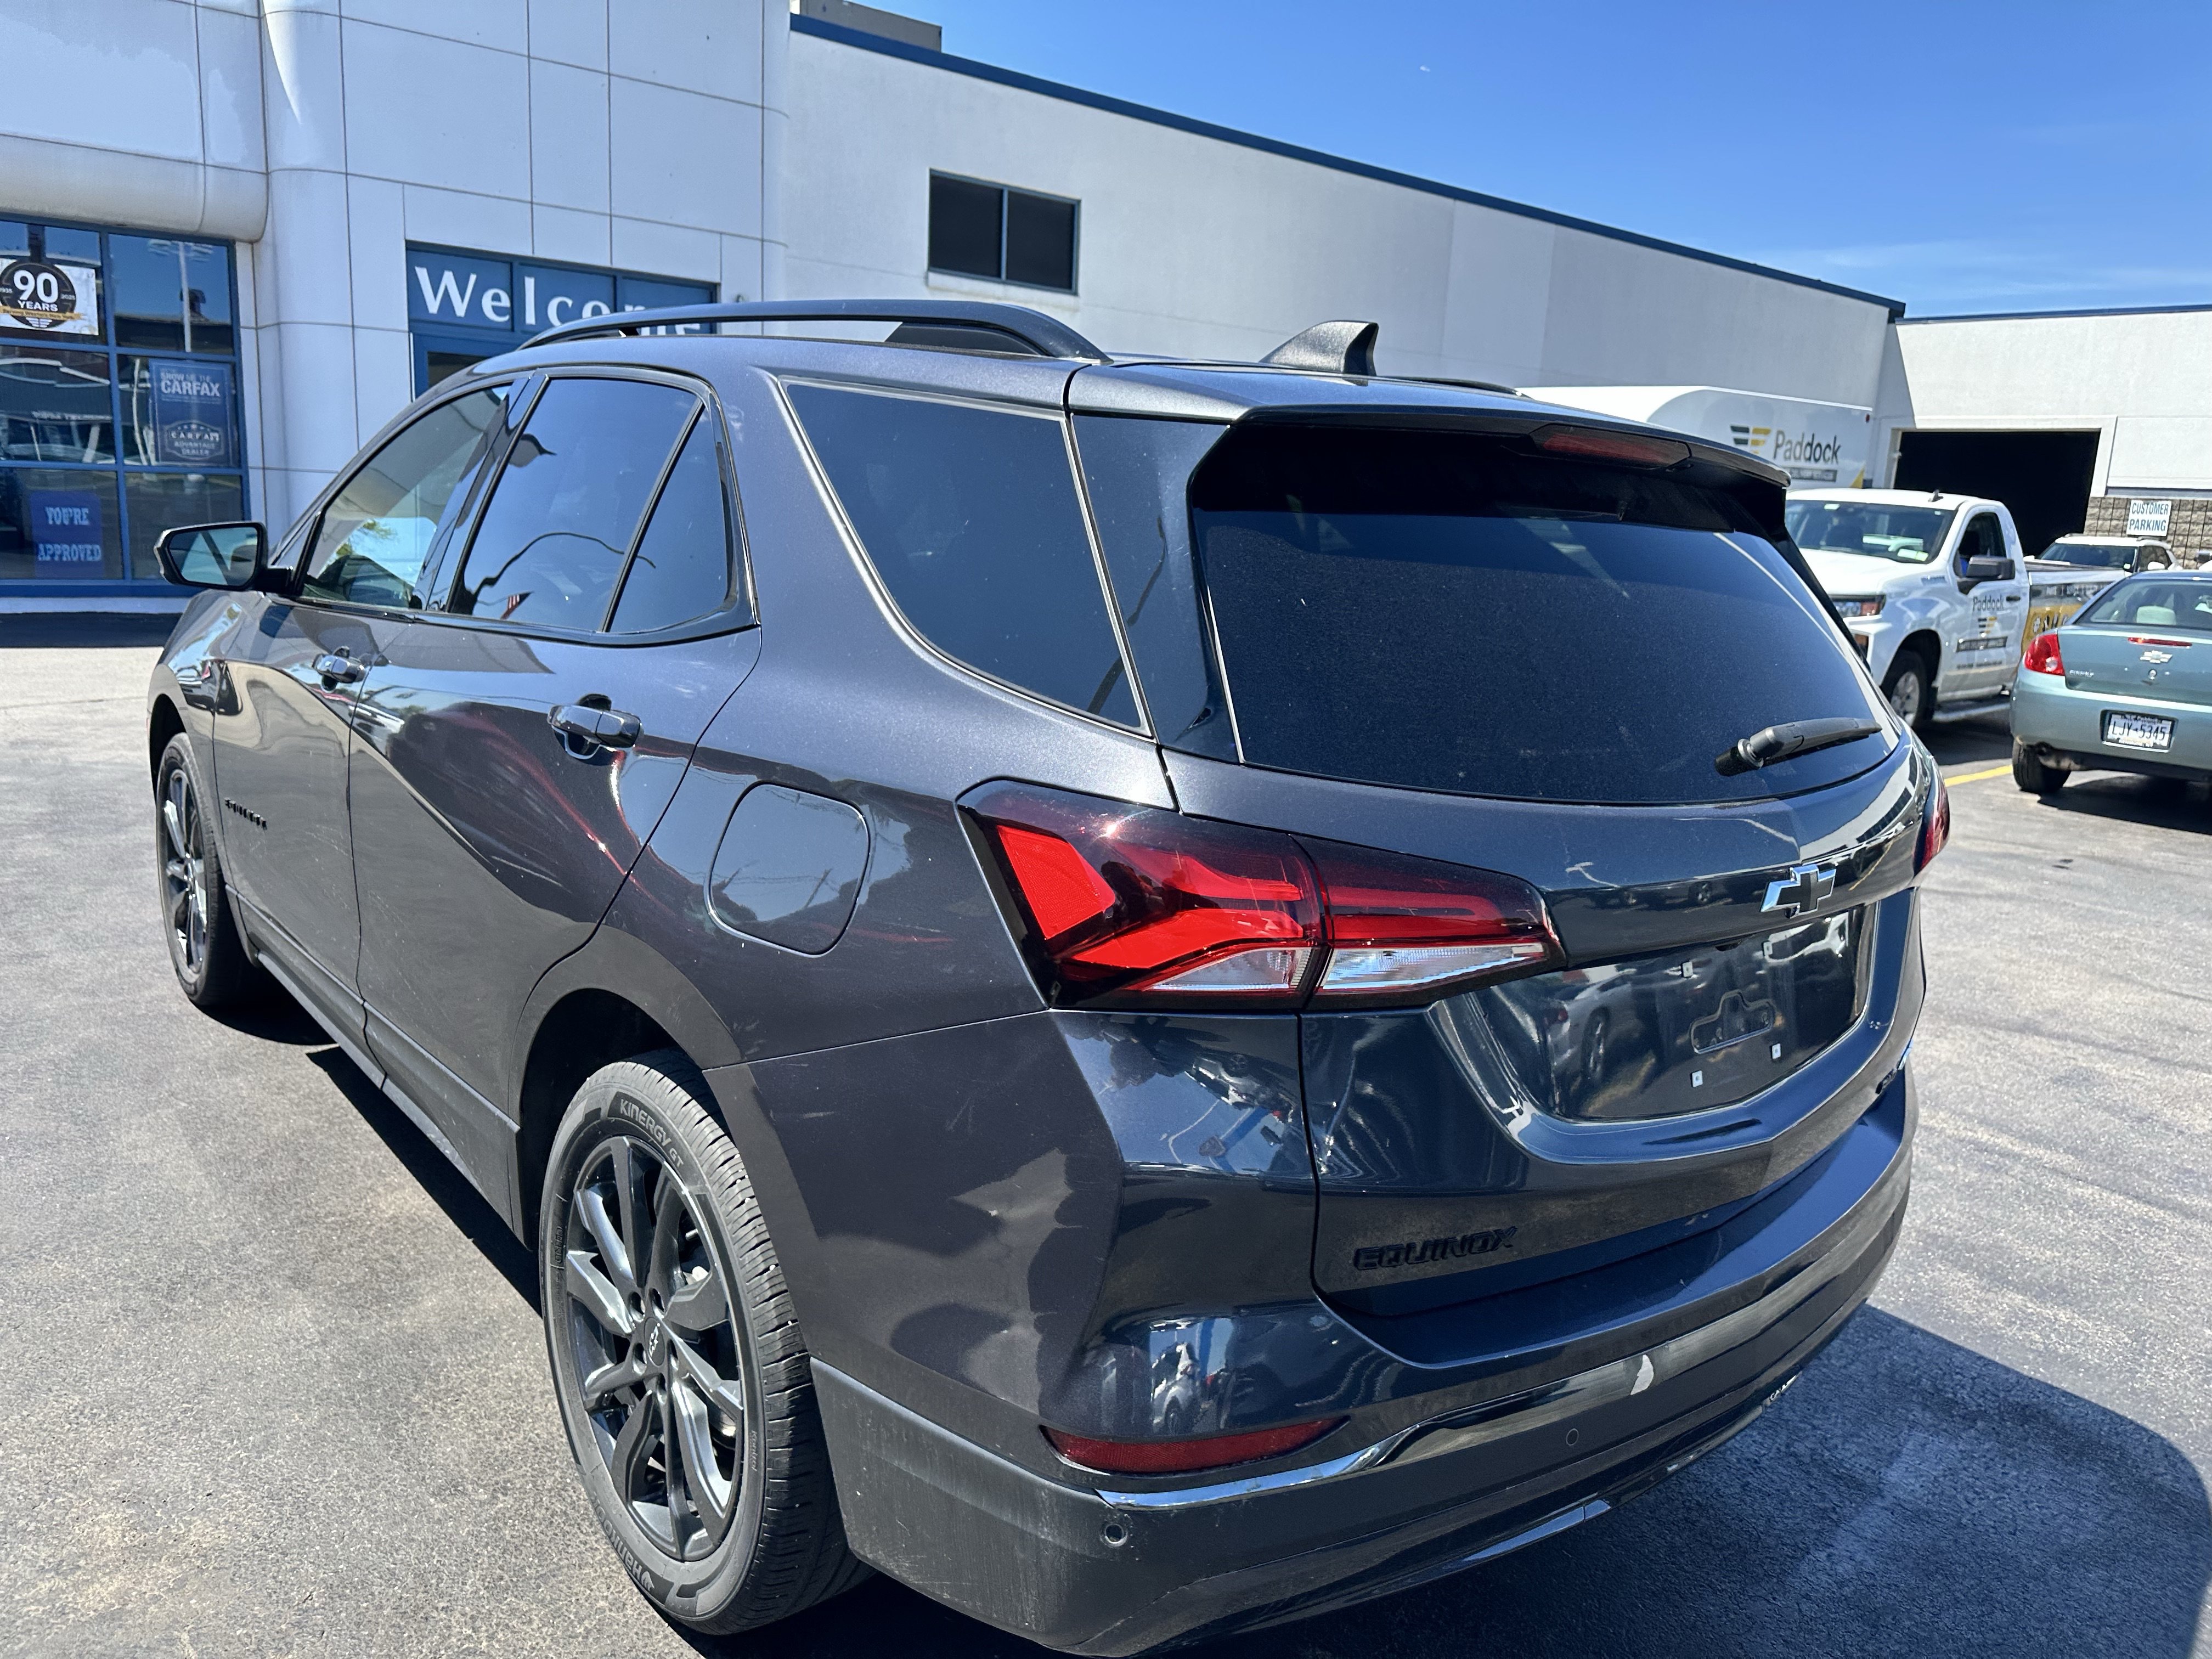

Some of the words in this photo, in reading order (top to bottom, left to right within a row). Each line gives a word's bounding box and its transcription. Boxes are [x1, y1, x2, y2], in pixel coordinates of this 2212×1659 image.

[13, 269, 59, 303] 90
[18, 300, 59, 312] YEARS
[161, 380, 220, 397] CARFAX
[1773, 430, 1841, 465] Paddock
[44, 507, 91, 526] YOU'RE
[2131, 502, 2169, 515] CUSTOMER
[2129, 518, 2166, 531] PARKING
[37, 543, 101, 561] APPROVED
[1973, 594, 2004, 612] Paddock
[620, 1099, 672, 1146] KINERGY
[669, 1148, 684, 1167] GT
[1353, 1226, 1517, 1271] EQUINOX
